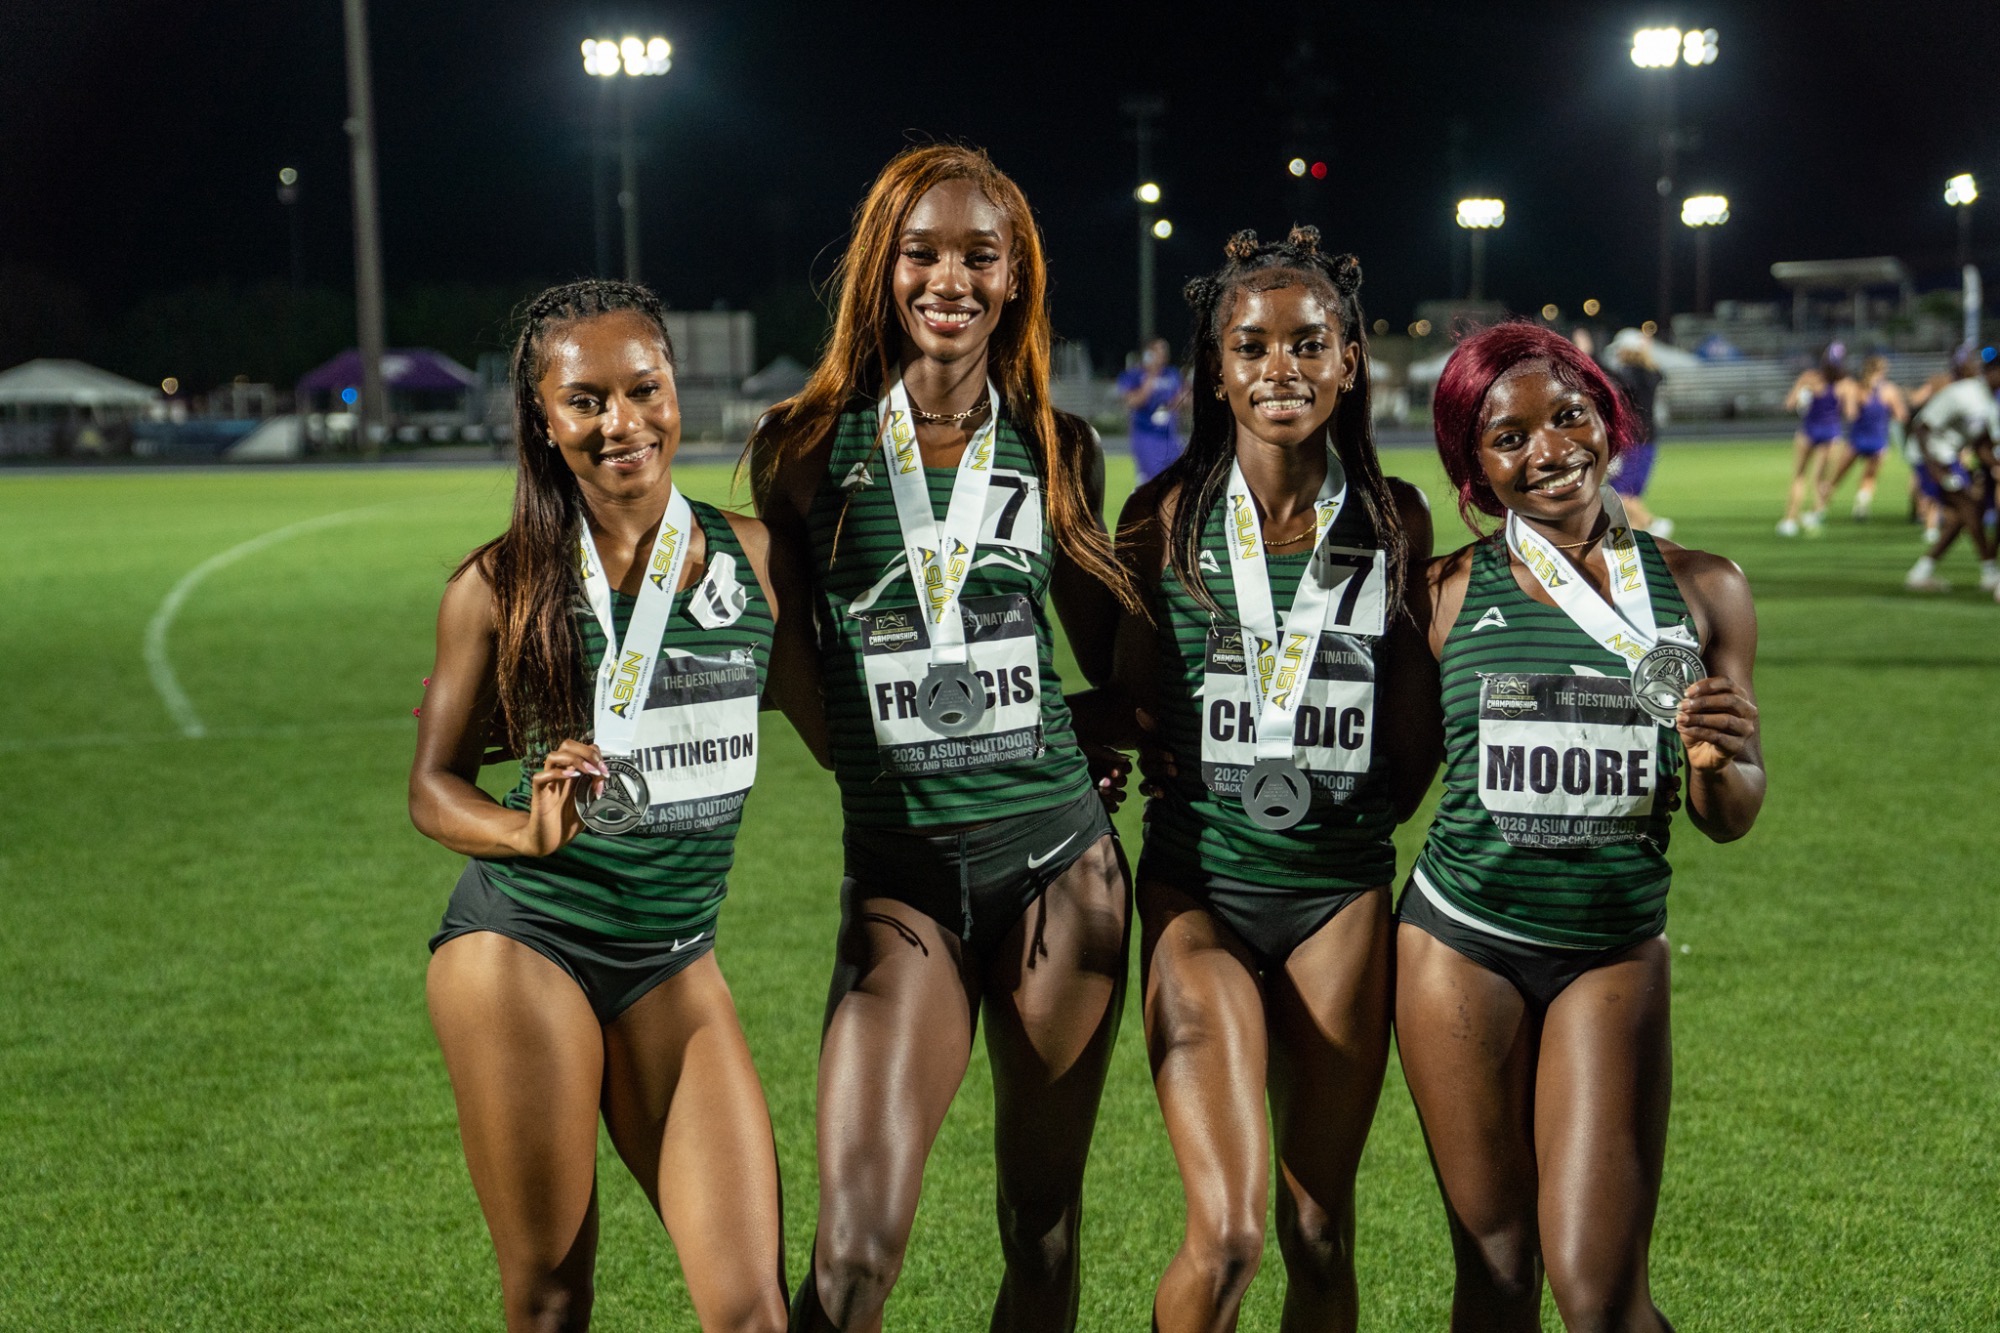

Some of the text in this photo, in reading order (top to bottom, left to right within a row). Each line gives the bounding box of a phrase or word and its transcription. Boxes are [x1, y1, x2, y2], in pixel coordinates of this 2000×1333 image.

[989, 474, 1029, 541] 7
[1330, 553, 1374, 627] 7
[868, 630, 918, 646] CHAMPIONSHIPS
[1212, 653, 1245, 663] CHAMPION
[1254, 636, 1276, 700] ASU
[1648, 648, 1674, 661] TRACK
[1681, 651, 1701, 672] FIELD
[663, 667, 750, 690] THE DESTINATION.
[874, 665, 1034, 721] FRCIS
[1554, 691, 1638, 710] THE DESTINATI
[1486, 699, 1538, 711] CHAMPIONSHIPS
[1209, 699, 1365, 751] CHDIC
[631, 732, 753, 773] HITTINGTON
[892, 731, 1032, 763] 2026 ASUN OUTDOOR
[895, 746, 1034, 773] TRACK AND FIELD CHAMPIONSHIPS
[1486, 744, 1649, 797] MOORE
[1214, 767, 1248, 783] 2026
[1214, 781, 1241, 793] TRACK
[658, 804, 694, 823] ASUN
[650, 824, 668, 833] AND
[669, 820, 692, 832] FIELD
[1530, 818, 1570, 834] ASUN
[1574, 819, 1637, 835] OUTDOOR
[1521, 833, 1540, 844] AND
